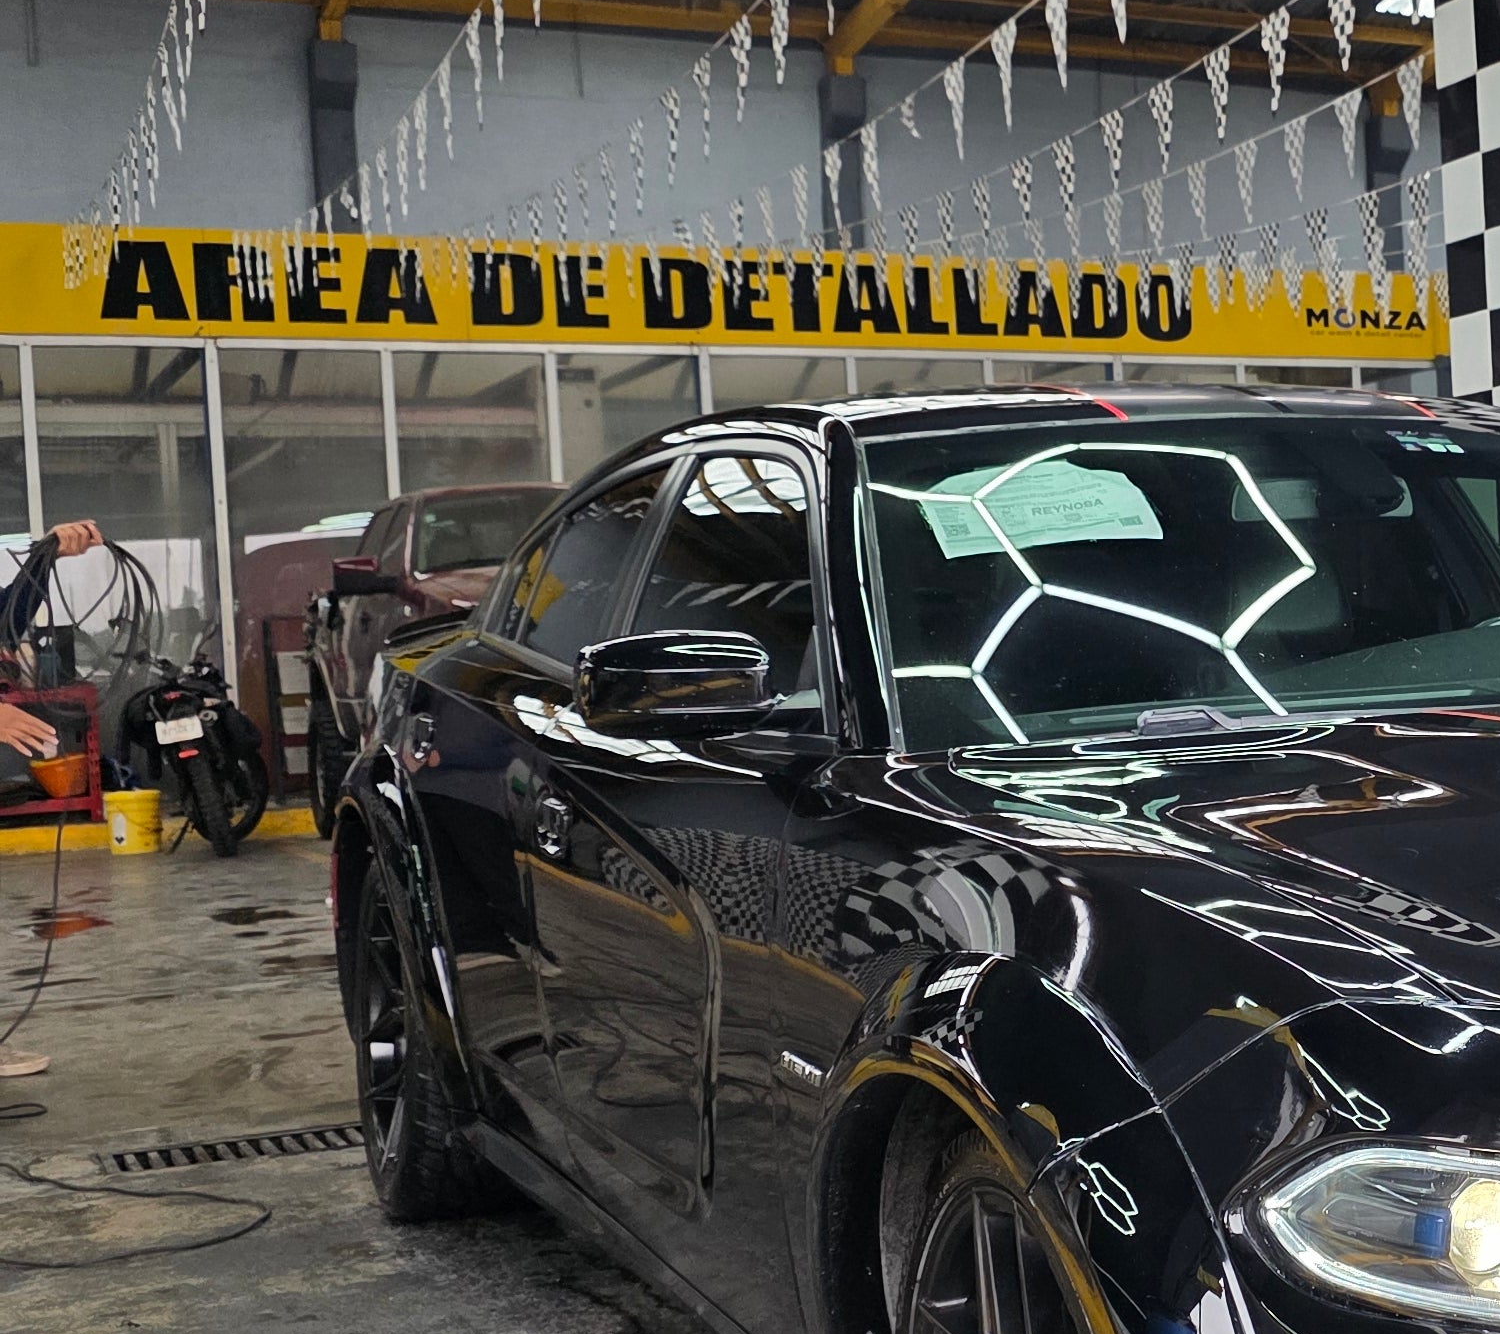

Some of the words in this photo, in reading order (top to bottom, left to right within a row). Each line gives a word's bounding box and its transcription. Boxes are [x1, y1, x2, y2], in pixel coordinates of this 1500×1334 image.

[101, 240, 438, 325] AREA
[472, 251, 610, 329] DE
[642, 257, 1193, 342] DETALLADO
[1306, 308, 1426, 330] MONZA
